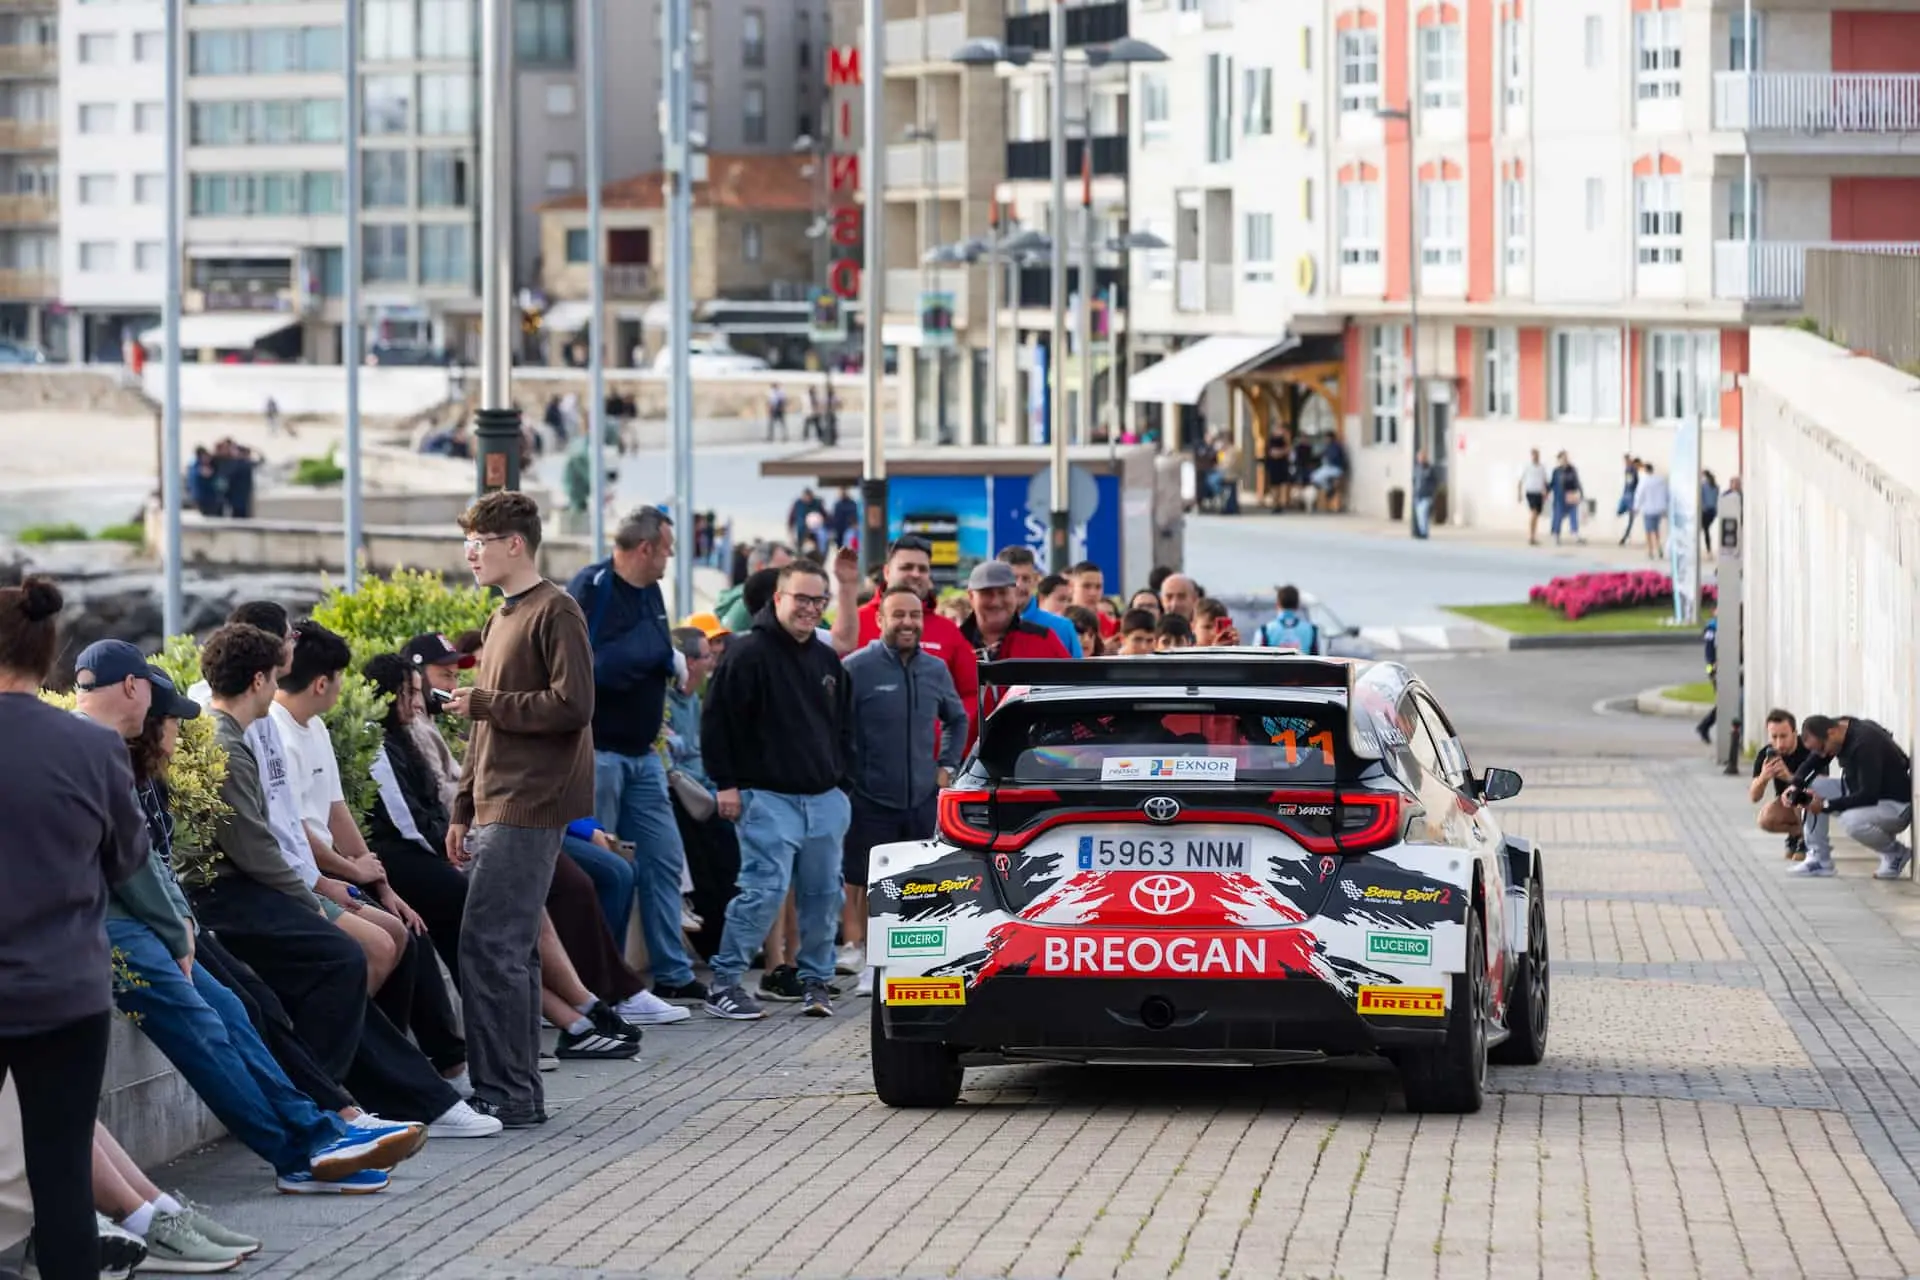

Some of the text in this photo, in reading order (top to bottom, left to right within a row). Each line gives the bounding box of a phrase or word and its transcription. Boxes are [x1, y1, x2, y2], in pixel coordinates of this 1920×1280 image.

[1271, 729, 1335, 766] 11
[1176, 760, 1229, 771] EXNOR
[1082, 855, 1088, 865] E
[1099, 840, 1244, 867] 5963 NNM
[938, 879, 974, 893] Sport
[972, 876, 983, 892] 2
[1403, 888, 1441, 903] Sport
[1439, 889, 1451, 904] 2
[894, 934, 940, 945] LUCEIRO
[1373, 938, 1425, 953] LUCEIRO
[1045, 937, 1266, 974] BREOGAN
[887, 983, 961, 1000] PIRELLI
[1361, 990, 1443, 1010] PIRELLI
